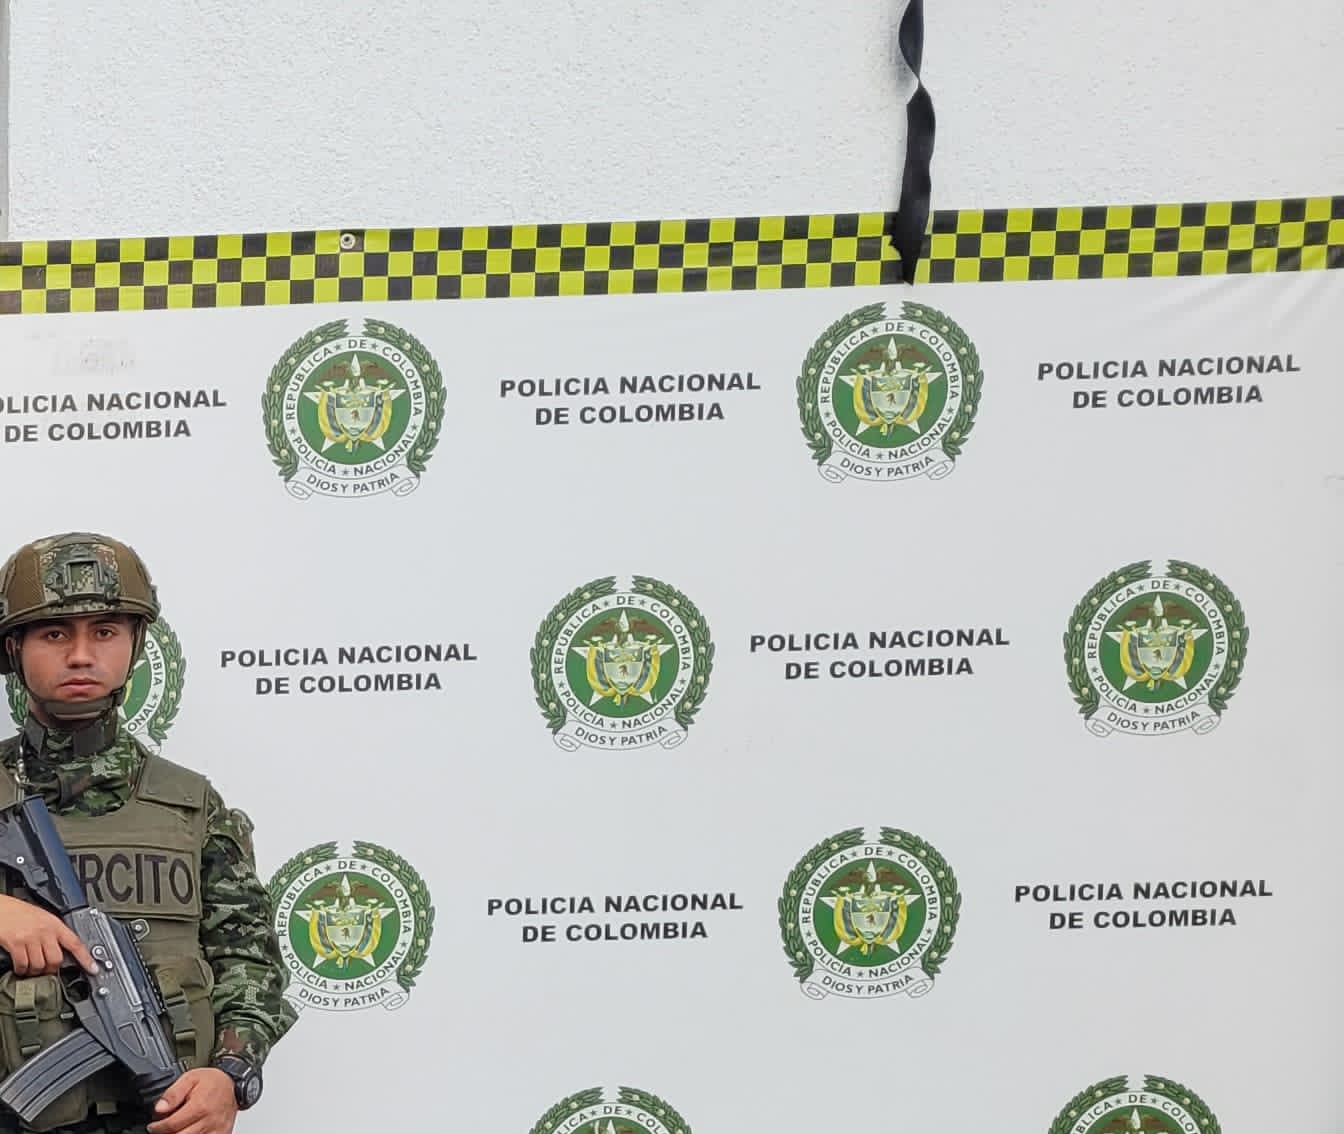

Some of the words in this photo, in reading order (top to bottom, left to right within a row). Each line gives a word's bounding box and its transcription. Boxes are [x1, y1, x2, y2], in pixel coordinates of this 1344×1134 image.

[1038, 360, 1147, 380] POLICIA
[1159, 355, 1300, 376] NACIONAL
[501, 378, 609, 397] POLICIA
[620, 373, 760, 393] NACIONAL
[88, 390, 226, 411] NACIONAL
[1073, 391, 1107, 408] DE
[1118, 386, 1262, 407] COLOMBIA
[536, 408, 569, 425] DE
[580, 403, 724, 424] COLOMBIA
[5, 425, 37, 442] DE
[48, 420, 190, 441] COLOMBIA
[1151, 580, 1169, 589] DE
[1183, 587, 1226, 655] COLOMBIA
[751, 632, 859, 652] POLICIA
[870, 628, 1009, 648] NACIONAL
[221, 648, 328, 667] POLICIA
[339, 644, 477, 664] NACIONAL
[786, 662, 819, 679] DE
[830, 658, 973, 678] COLOMBIA
[256, 678, 289, 695] DE
[300, 673, 441, 693] COLOMBIA
[1155, 670, 1217, 713] NACIONAL
[1154, 711, 1200, 730] PATRIA
[1015, 884, 1123, 902] POLICIA
[1134, 880, 1272, 899] NACIONAL
[488, 897, 594, 915] POLICIA
[605, 893, 743, 912] NACIONAL
[1050, 912, 1083, 929] DE
[1094, 909, 1236, 928] COLOMBIA
[523, 926, 556, 942] DE
[566, 922, 707, 941] COLOMBIA
